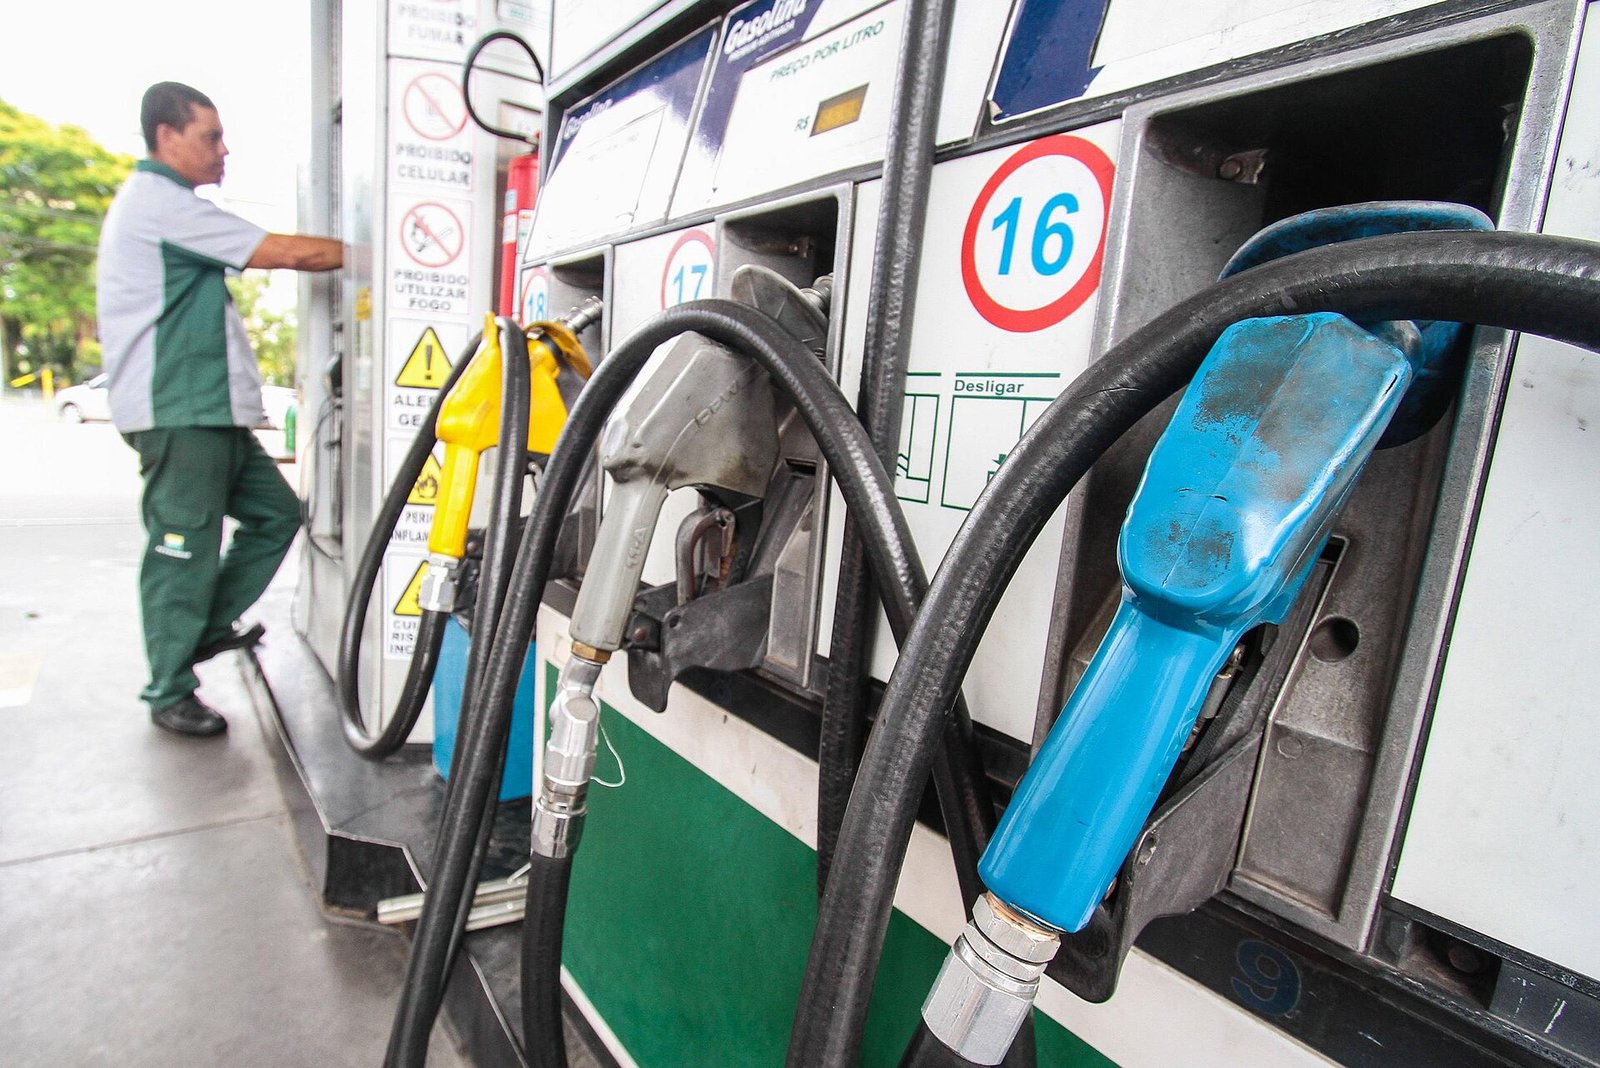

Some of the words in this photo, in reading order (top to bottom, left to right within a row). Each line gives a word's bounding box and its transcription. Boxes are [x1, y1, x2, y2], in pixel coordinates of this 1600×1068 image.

[812, 41, 840, 63] POR
[842, 20, 885, 50] LITRO
[396, 143, 472, 165] PROIBIDO
[398, 164, 470, 185] CELULAR
[991, 192, 1079, 276] 16
[394, 269, 468, 286] PROIBIDO
[673, 264, 708, 305] 17
[395, 282, 466, 299] UTILIZAR
[408, 297, 451, 311] FOGO
[528, 291, 545, 324] 18
[953, 379, 1024, 396] Desligar
[1230, 940, 1301, 1017] 9
